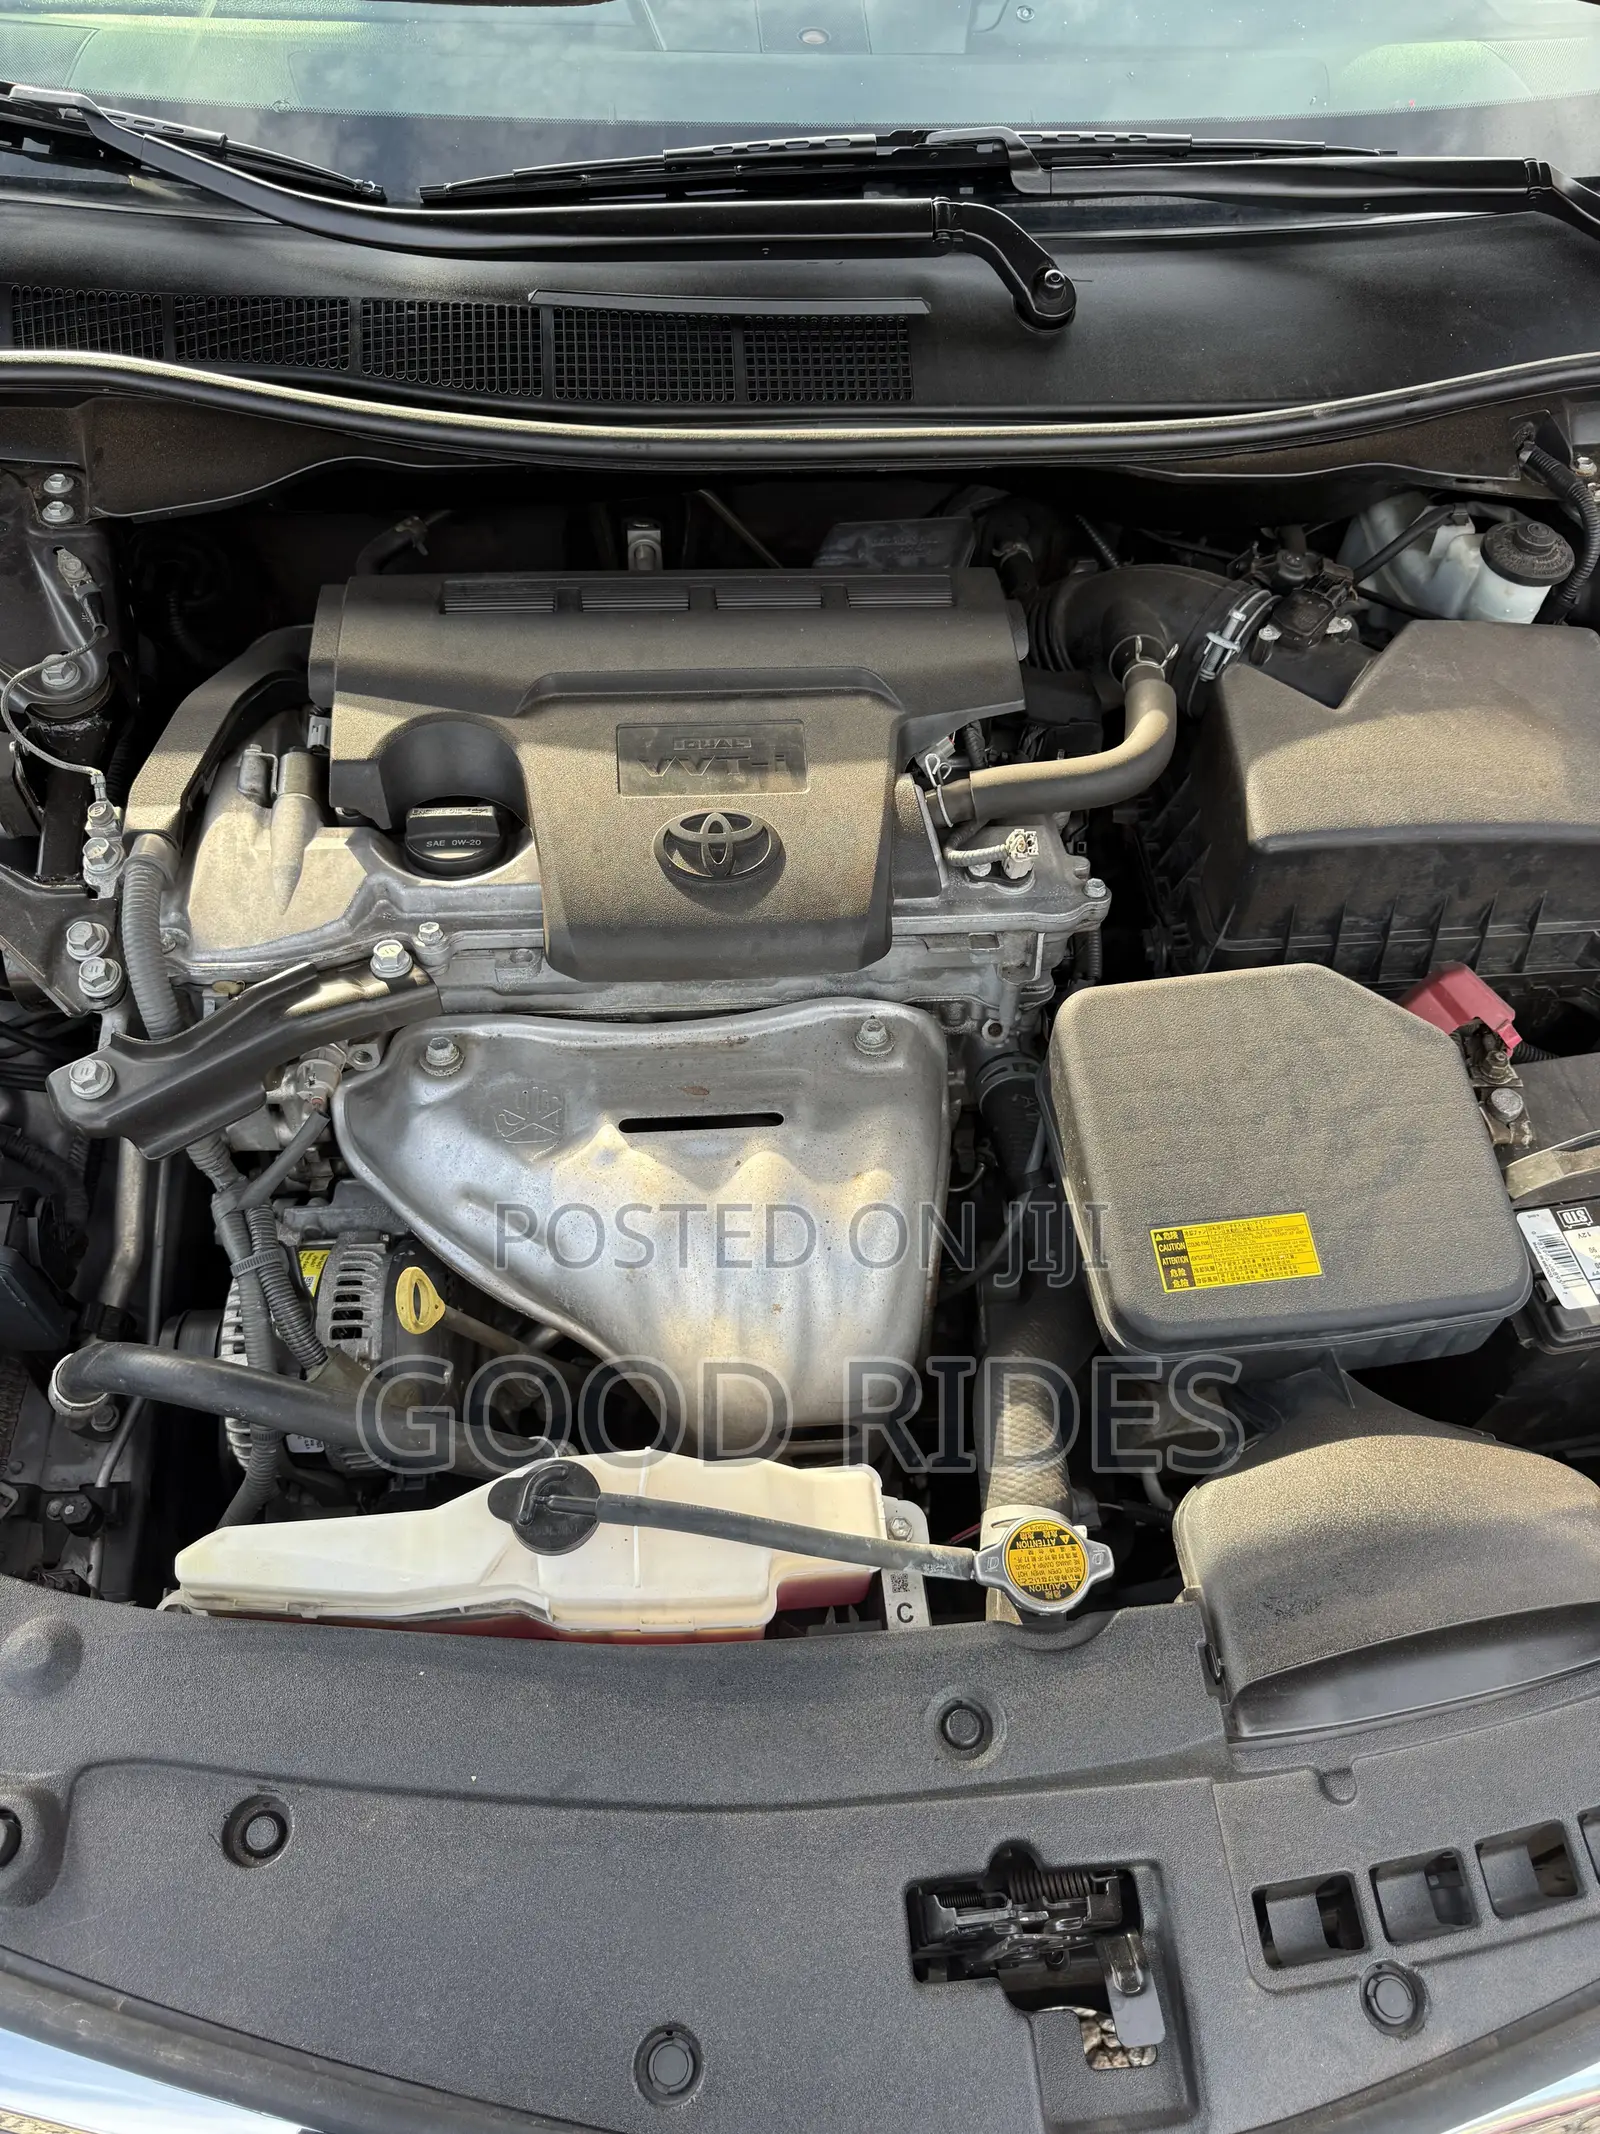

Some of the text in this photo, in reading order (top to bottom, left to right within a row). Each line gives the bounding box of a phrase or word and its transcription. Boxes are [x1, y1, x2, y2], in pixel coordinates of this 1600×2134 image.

[426, 839, 445, 847] SAE
[1562, 1209, 1588, 1224] STD
[1578, 1231, 1591, 1239] 12V
[1158, 1242, 1186, 1252] CAUTION
[1161, 1255, 1189, 1265] ATTENTION
[1016, 1538, 1056, 1549] ATTENTION
[1028, 1582, 1067, 1592] CAUTION
[896, 1602, 914, 1623] C
